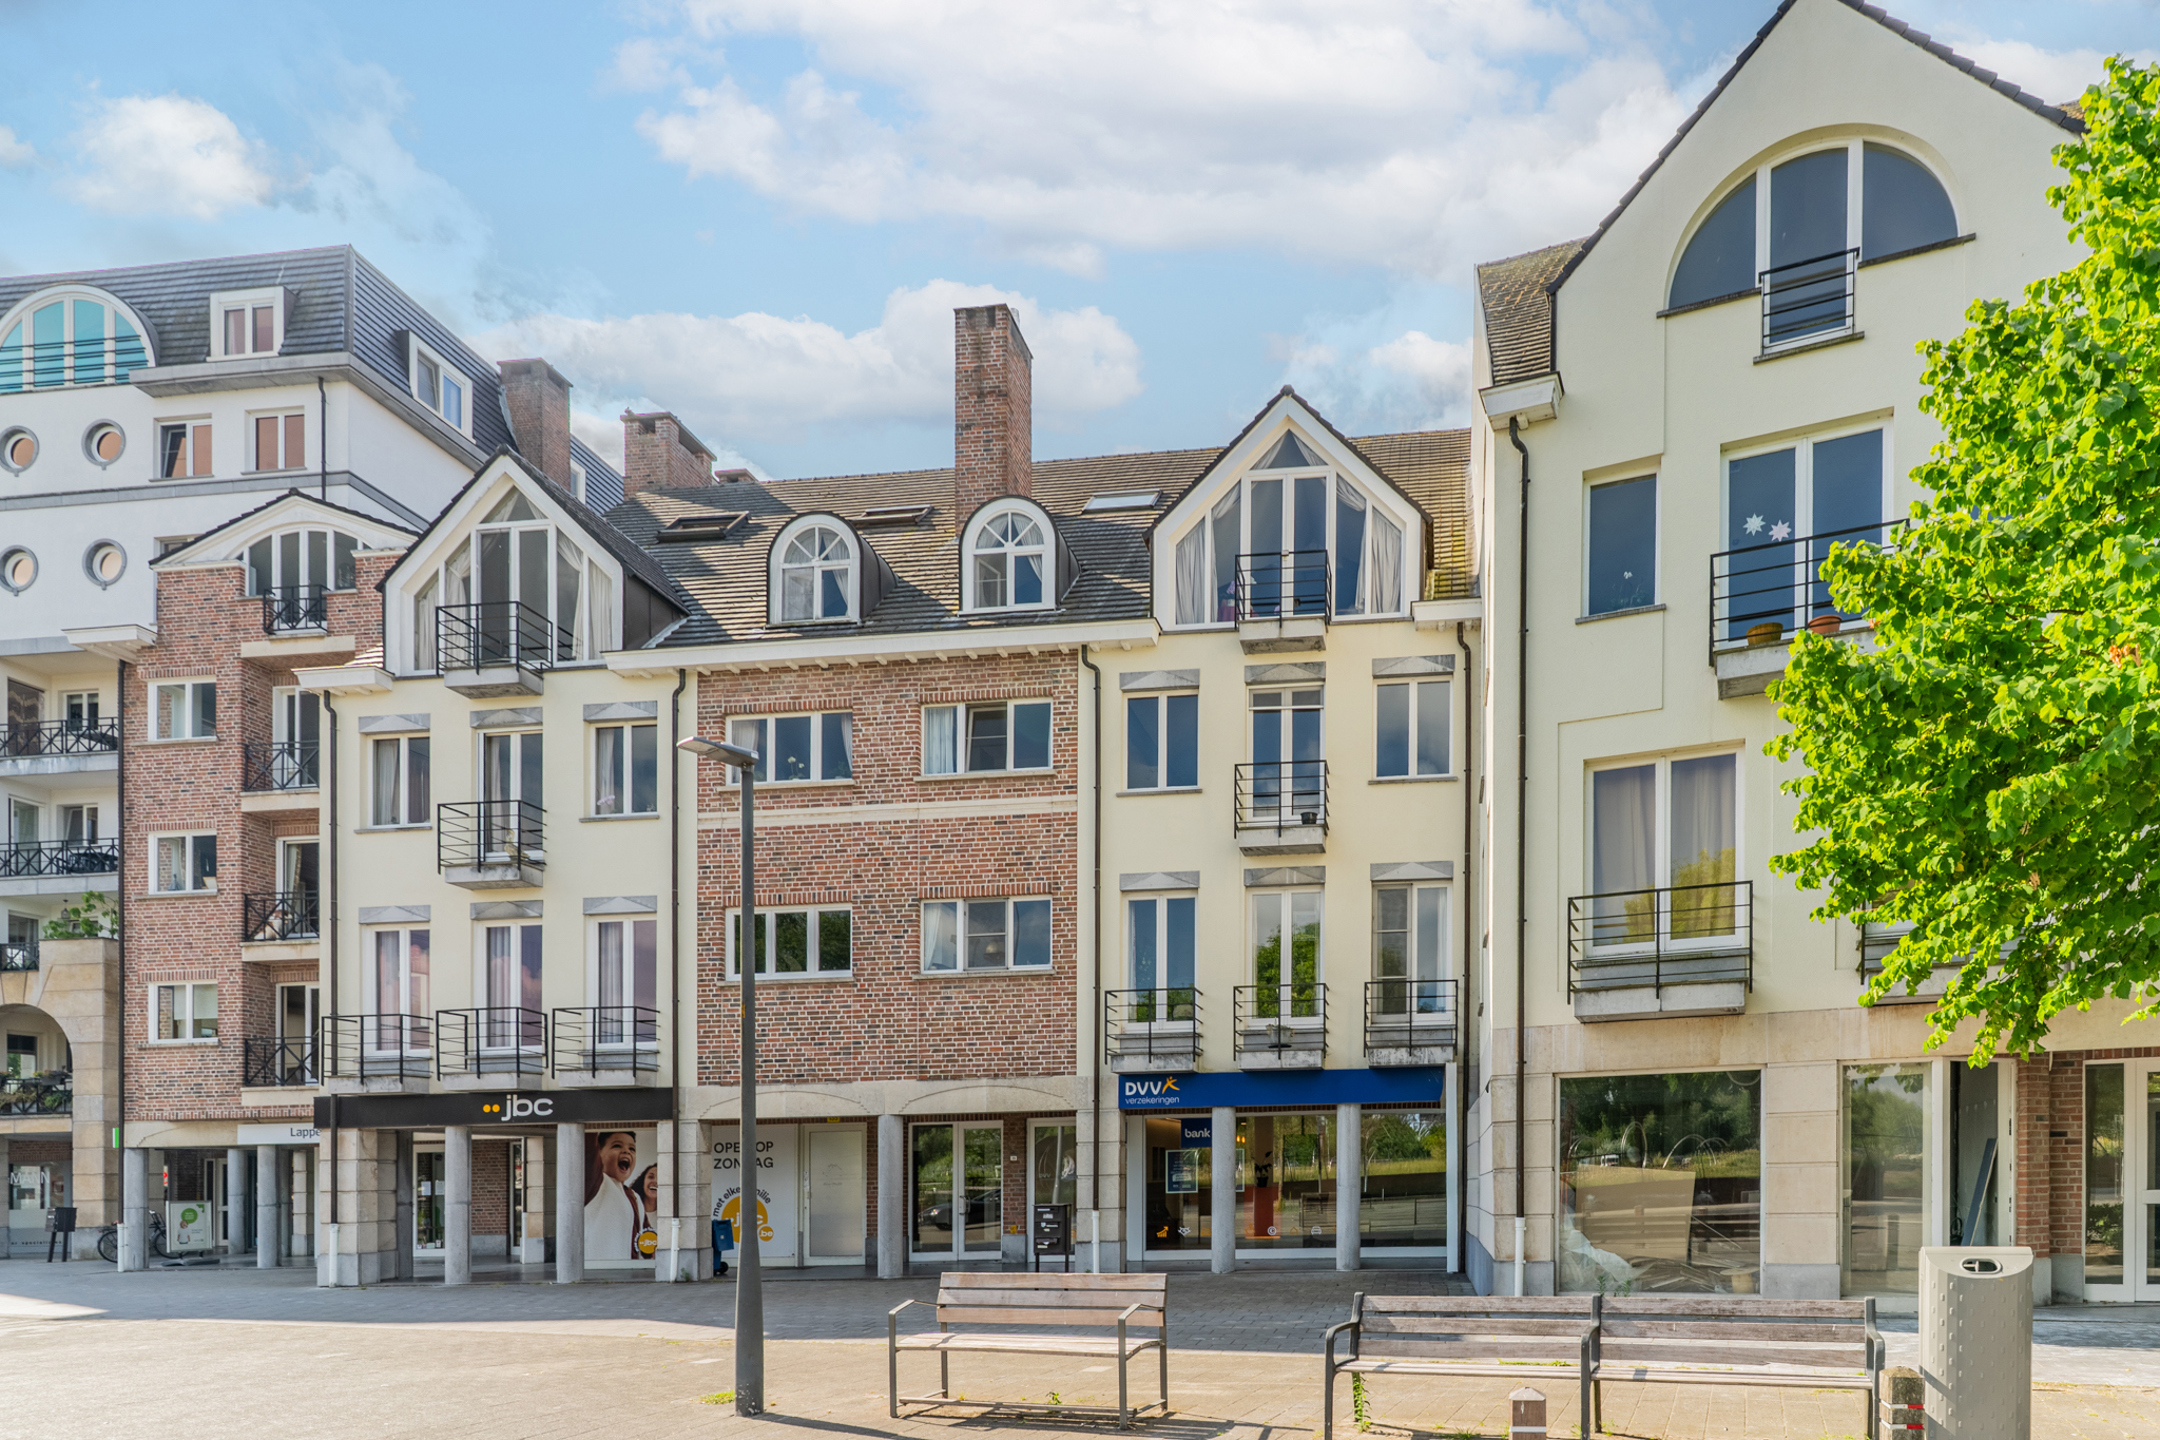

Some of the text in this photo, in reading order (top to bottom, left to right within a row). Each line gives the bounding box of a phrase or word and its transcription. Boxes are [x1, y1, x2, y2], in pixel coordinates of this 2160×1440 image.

[1125, 1081, 1162, 1096] DVV
[1125, 1096, 1180, 1105] verzekeringen
[501, 1094, 554, 1121] jbc
[1184, 1128, 1211, 1138] bank
[713, 1141, 774, 1153] OPE OP
[713, 1157, 774, 1169] ZONAG
[713, 1187, 771, 1217] met elke ilie
